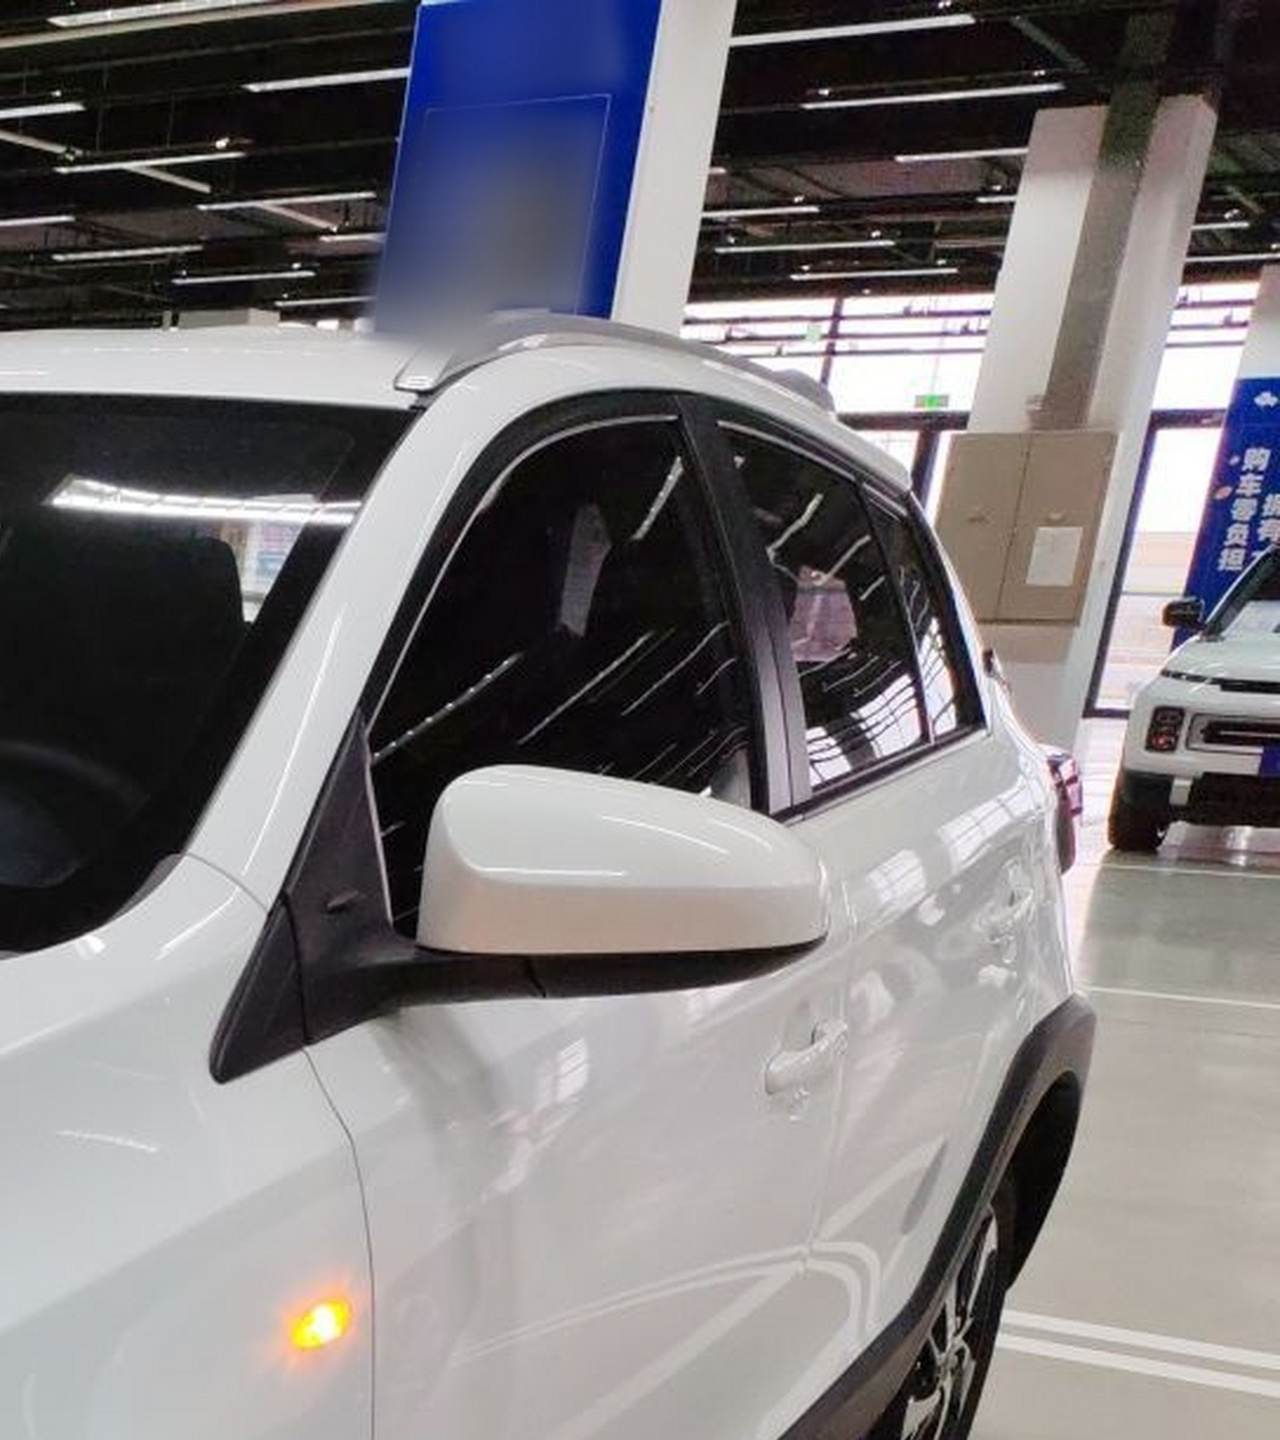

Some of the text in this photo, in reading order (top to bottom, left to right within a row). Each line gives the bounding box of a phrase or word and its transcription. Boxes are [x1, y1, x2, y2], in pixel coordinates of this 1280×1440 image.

[1218, 447, 1271, 571] 购车零负担
